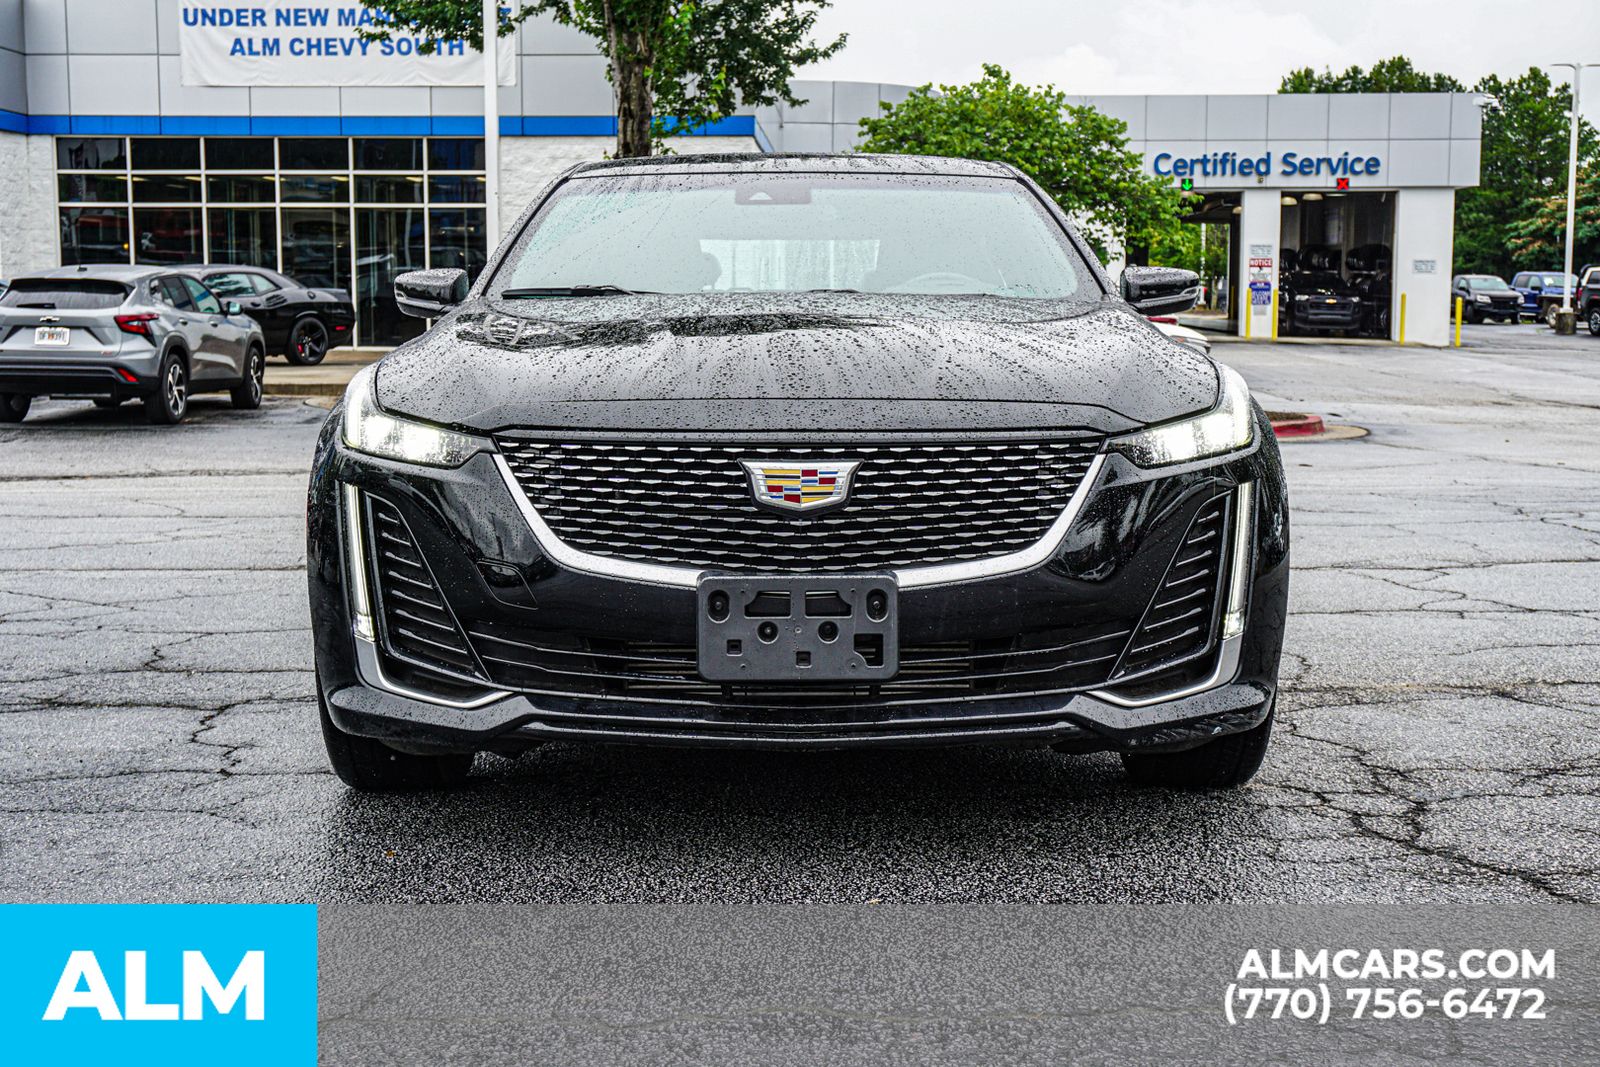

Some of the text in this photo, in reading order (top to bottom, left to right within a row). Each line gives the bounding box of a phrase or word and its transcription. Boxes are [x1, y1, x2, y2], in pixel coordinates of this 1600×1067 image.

[183, 8, 267, 27] UNDER
[275, 8, 329, 27] NEW
[230, 37, 464, 56] ALM CHEVY SOUTH
[1153, 151, 1381, 177] Certified Service
